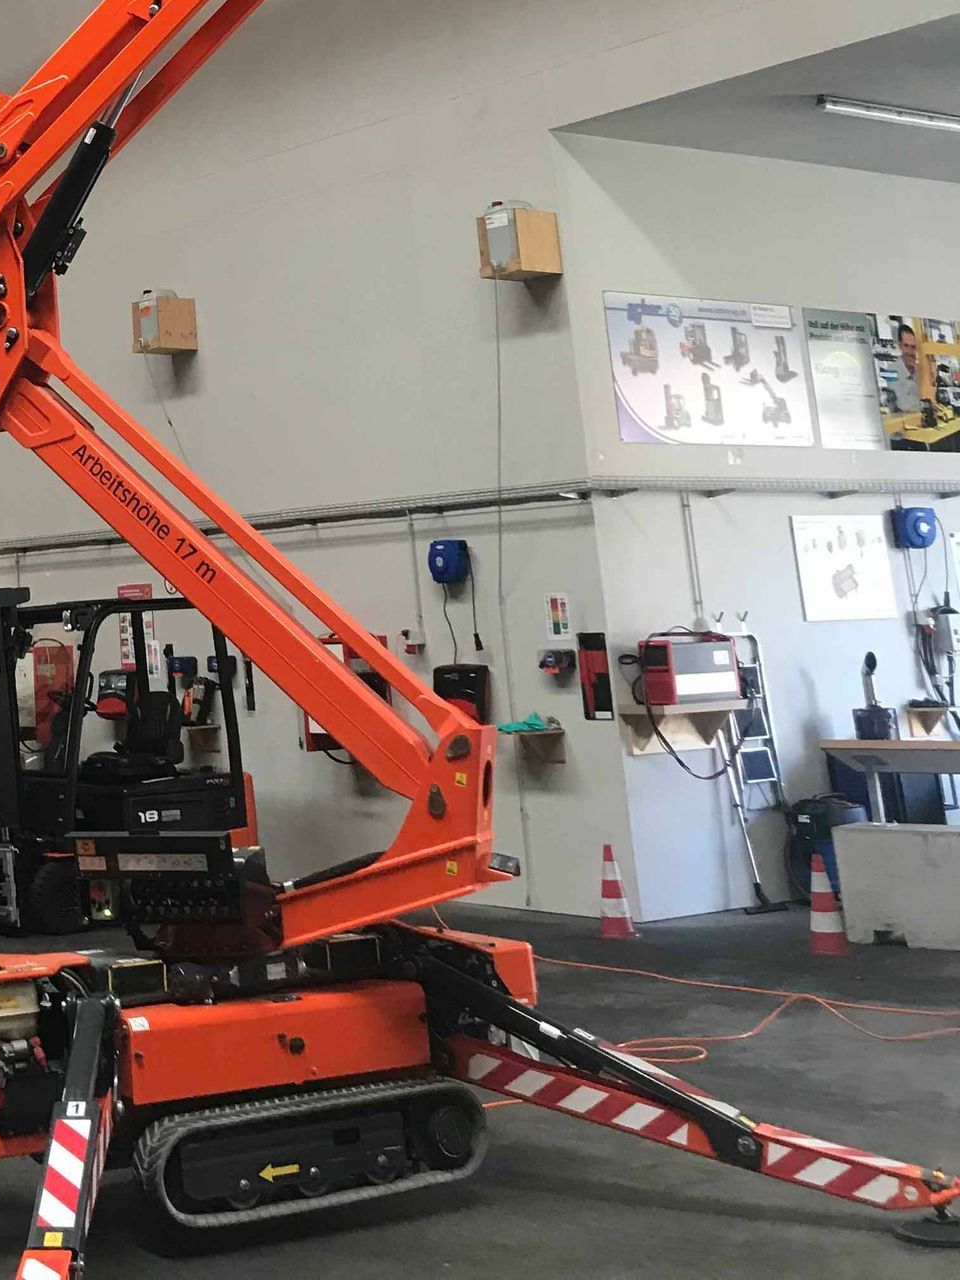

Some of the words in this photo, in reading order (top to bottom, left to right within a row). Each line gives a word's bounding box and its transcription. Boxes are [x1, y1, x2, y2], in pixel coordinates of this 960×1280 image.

[72, 444, 170, 540] Arbeitshöhe
[174, 538, 198, 561] 17
[195, 560, 217, 584] m
[137, 809, 159, 824] 18
[71, 1102, 80, 1115] 1
